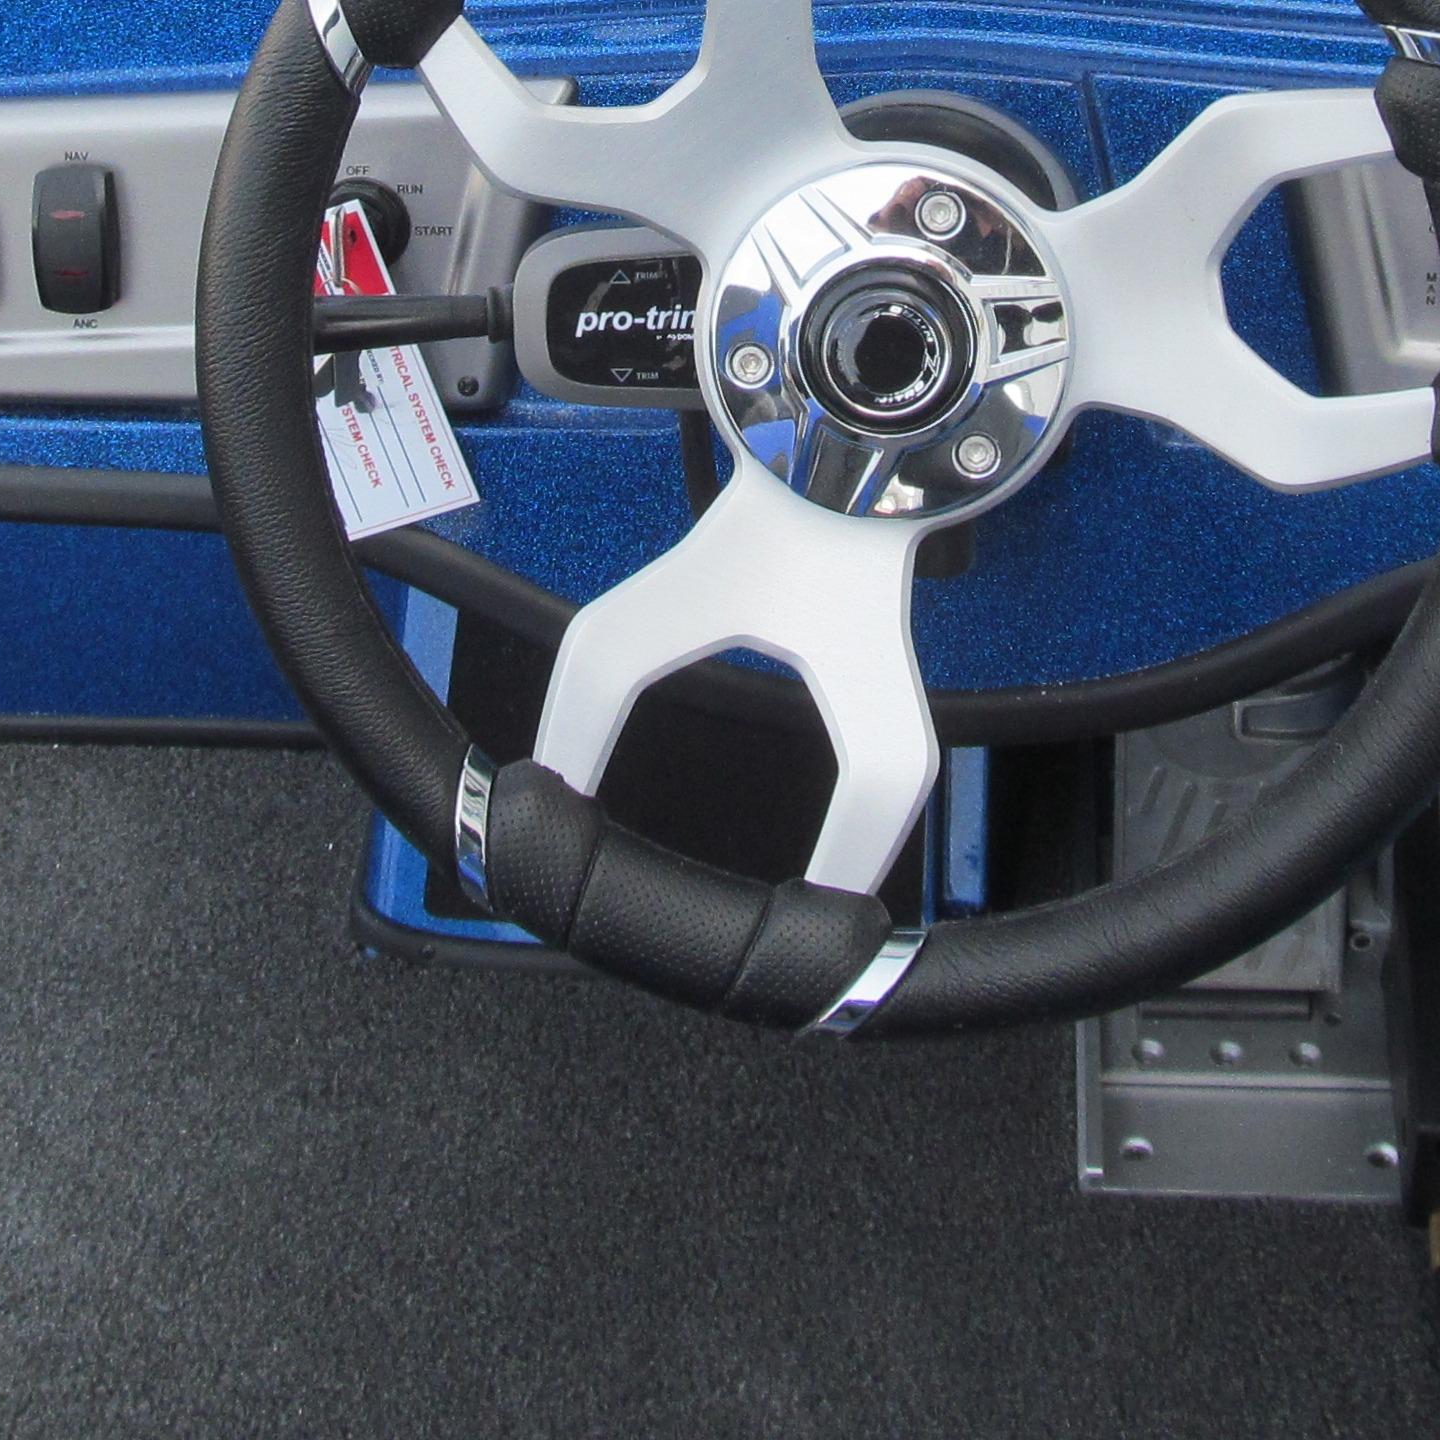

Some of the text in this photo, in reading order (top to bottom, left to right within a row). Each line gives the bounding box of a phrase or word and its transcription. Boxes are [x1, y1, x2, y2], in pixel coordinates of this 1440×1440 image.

[64, 151, 89, 161] NAV
[345, 165, 370, 176] OFF
[397, 184, 423, 195] RUN
[414, 226, 454, 237] START
[635, 271, 658, 279] TRIM
[73, 319, 98, 329] ANC
[636, 371, 659, 380] TRIM
[390, 345, 456, 490] TRICAL SYSTEM CHECK
[341, 404, 383, 489] STEM CHECK
